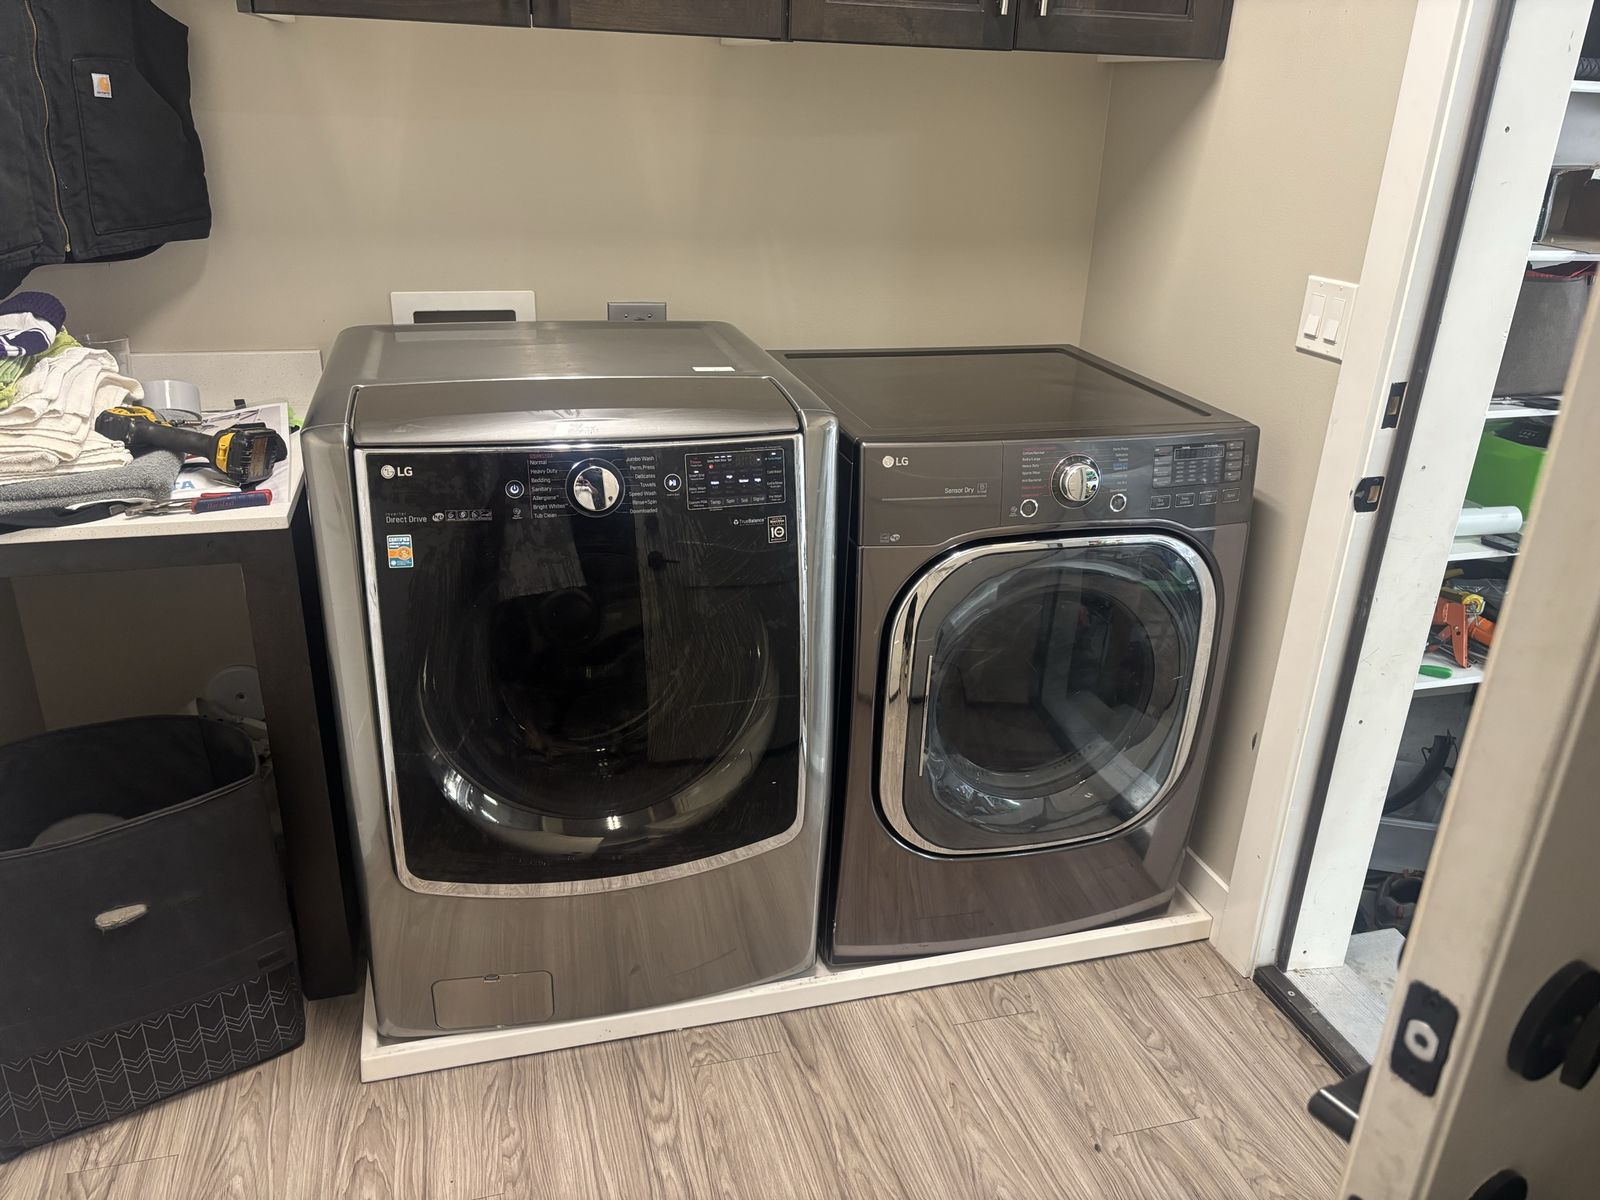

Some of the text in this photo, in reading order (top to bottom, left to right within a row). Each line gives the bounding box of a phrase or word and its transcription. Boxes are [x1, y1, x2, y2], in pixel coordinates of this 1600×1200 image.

[895, 456, 909, 466] LG
[397, 466, 413, 477] LG
[944, 487, 963, 495] Sensor
[964, 486, 975, 494] Dry
[385, 515, 408, 524] Direct
[408, 515, 428, 523] Drive
[771, 526, 784, 538] 10
